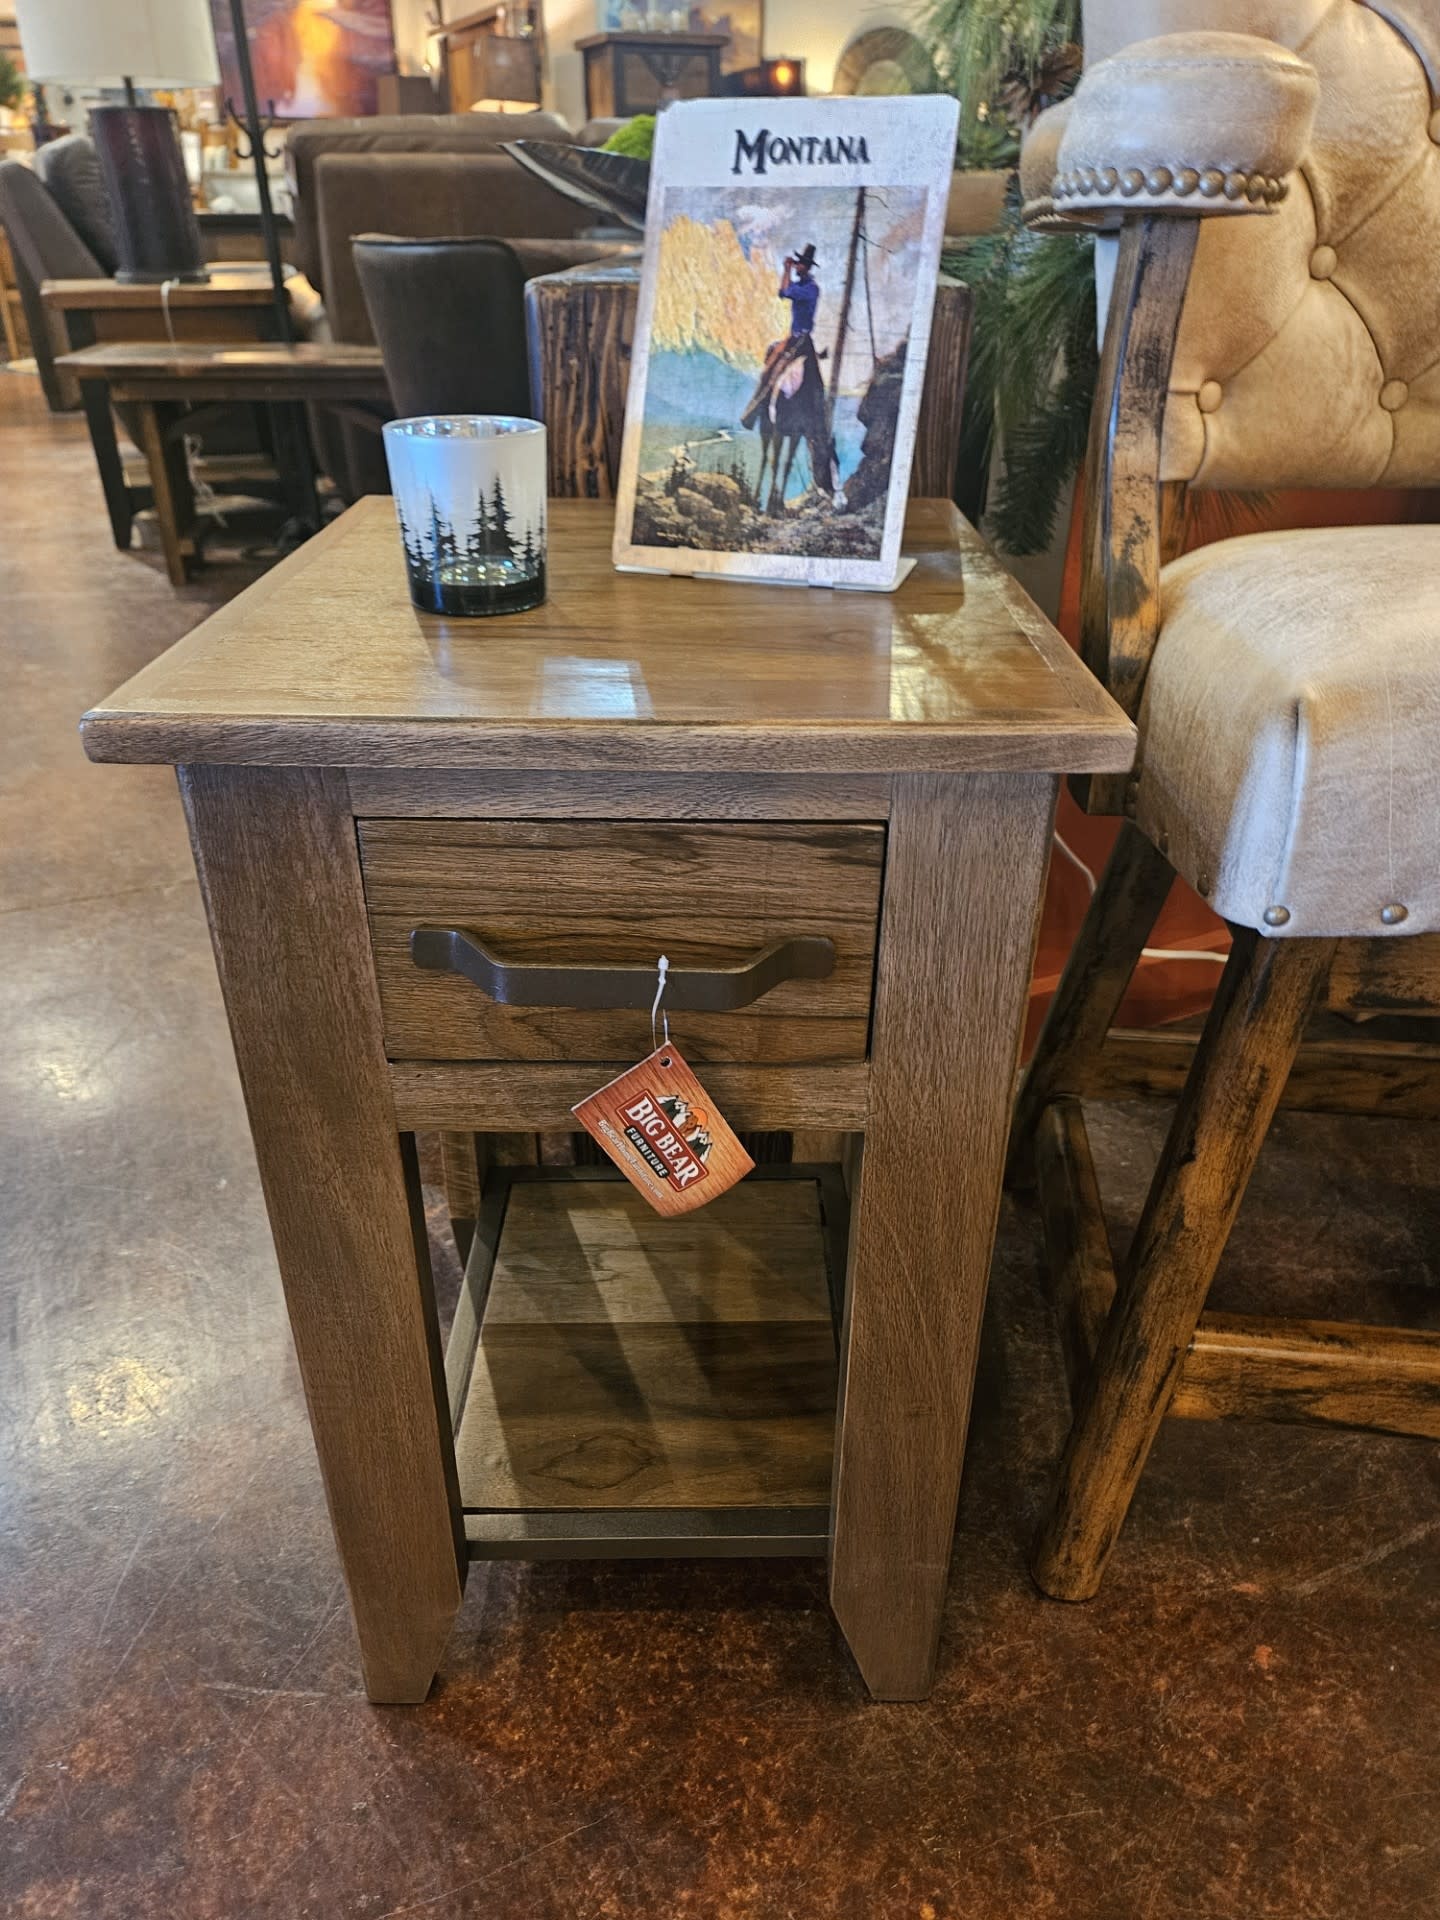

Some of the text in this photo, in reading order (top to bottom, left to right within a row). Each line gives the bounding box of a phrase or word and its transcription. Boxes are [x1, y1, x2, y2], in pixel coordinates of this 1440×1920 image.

[731, 129, 870, 174] MONTANA
[625, 1096, 699, 1187] BIG BEAR
[626, 1127, 668, 1177] FURNITURE
